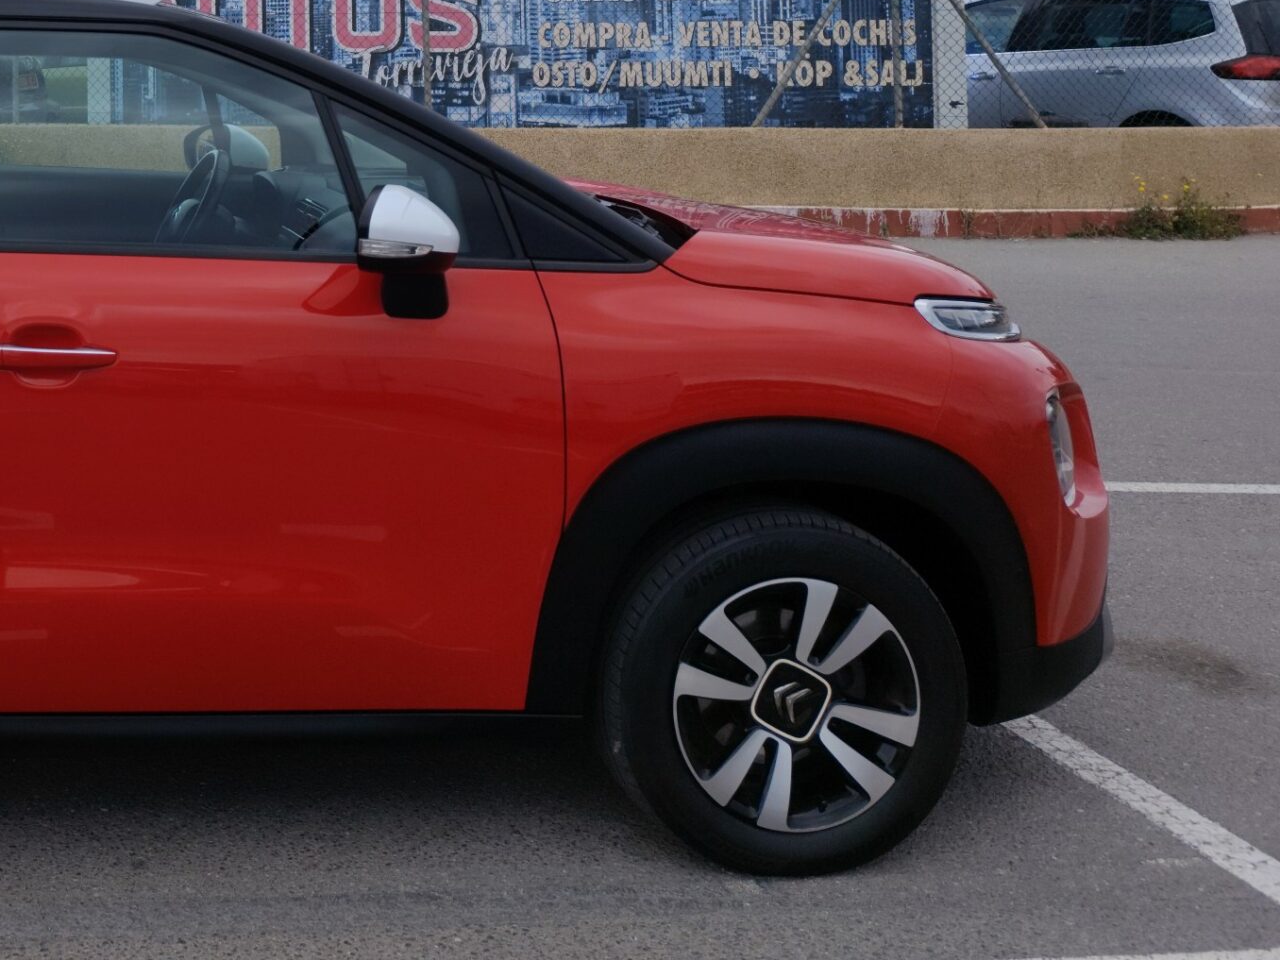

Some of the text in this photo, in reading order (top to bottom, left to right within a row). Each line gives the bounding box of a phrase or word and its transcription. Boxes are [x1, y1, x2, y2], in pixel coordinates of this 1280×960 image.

[538, 21, 653, 50] COMPRA
[678, 19, 762, 48] VENTA
[773, 20, 807, 47] DE
